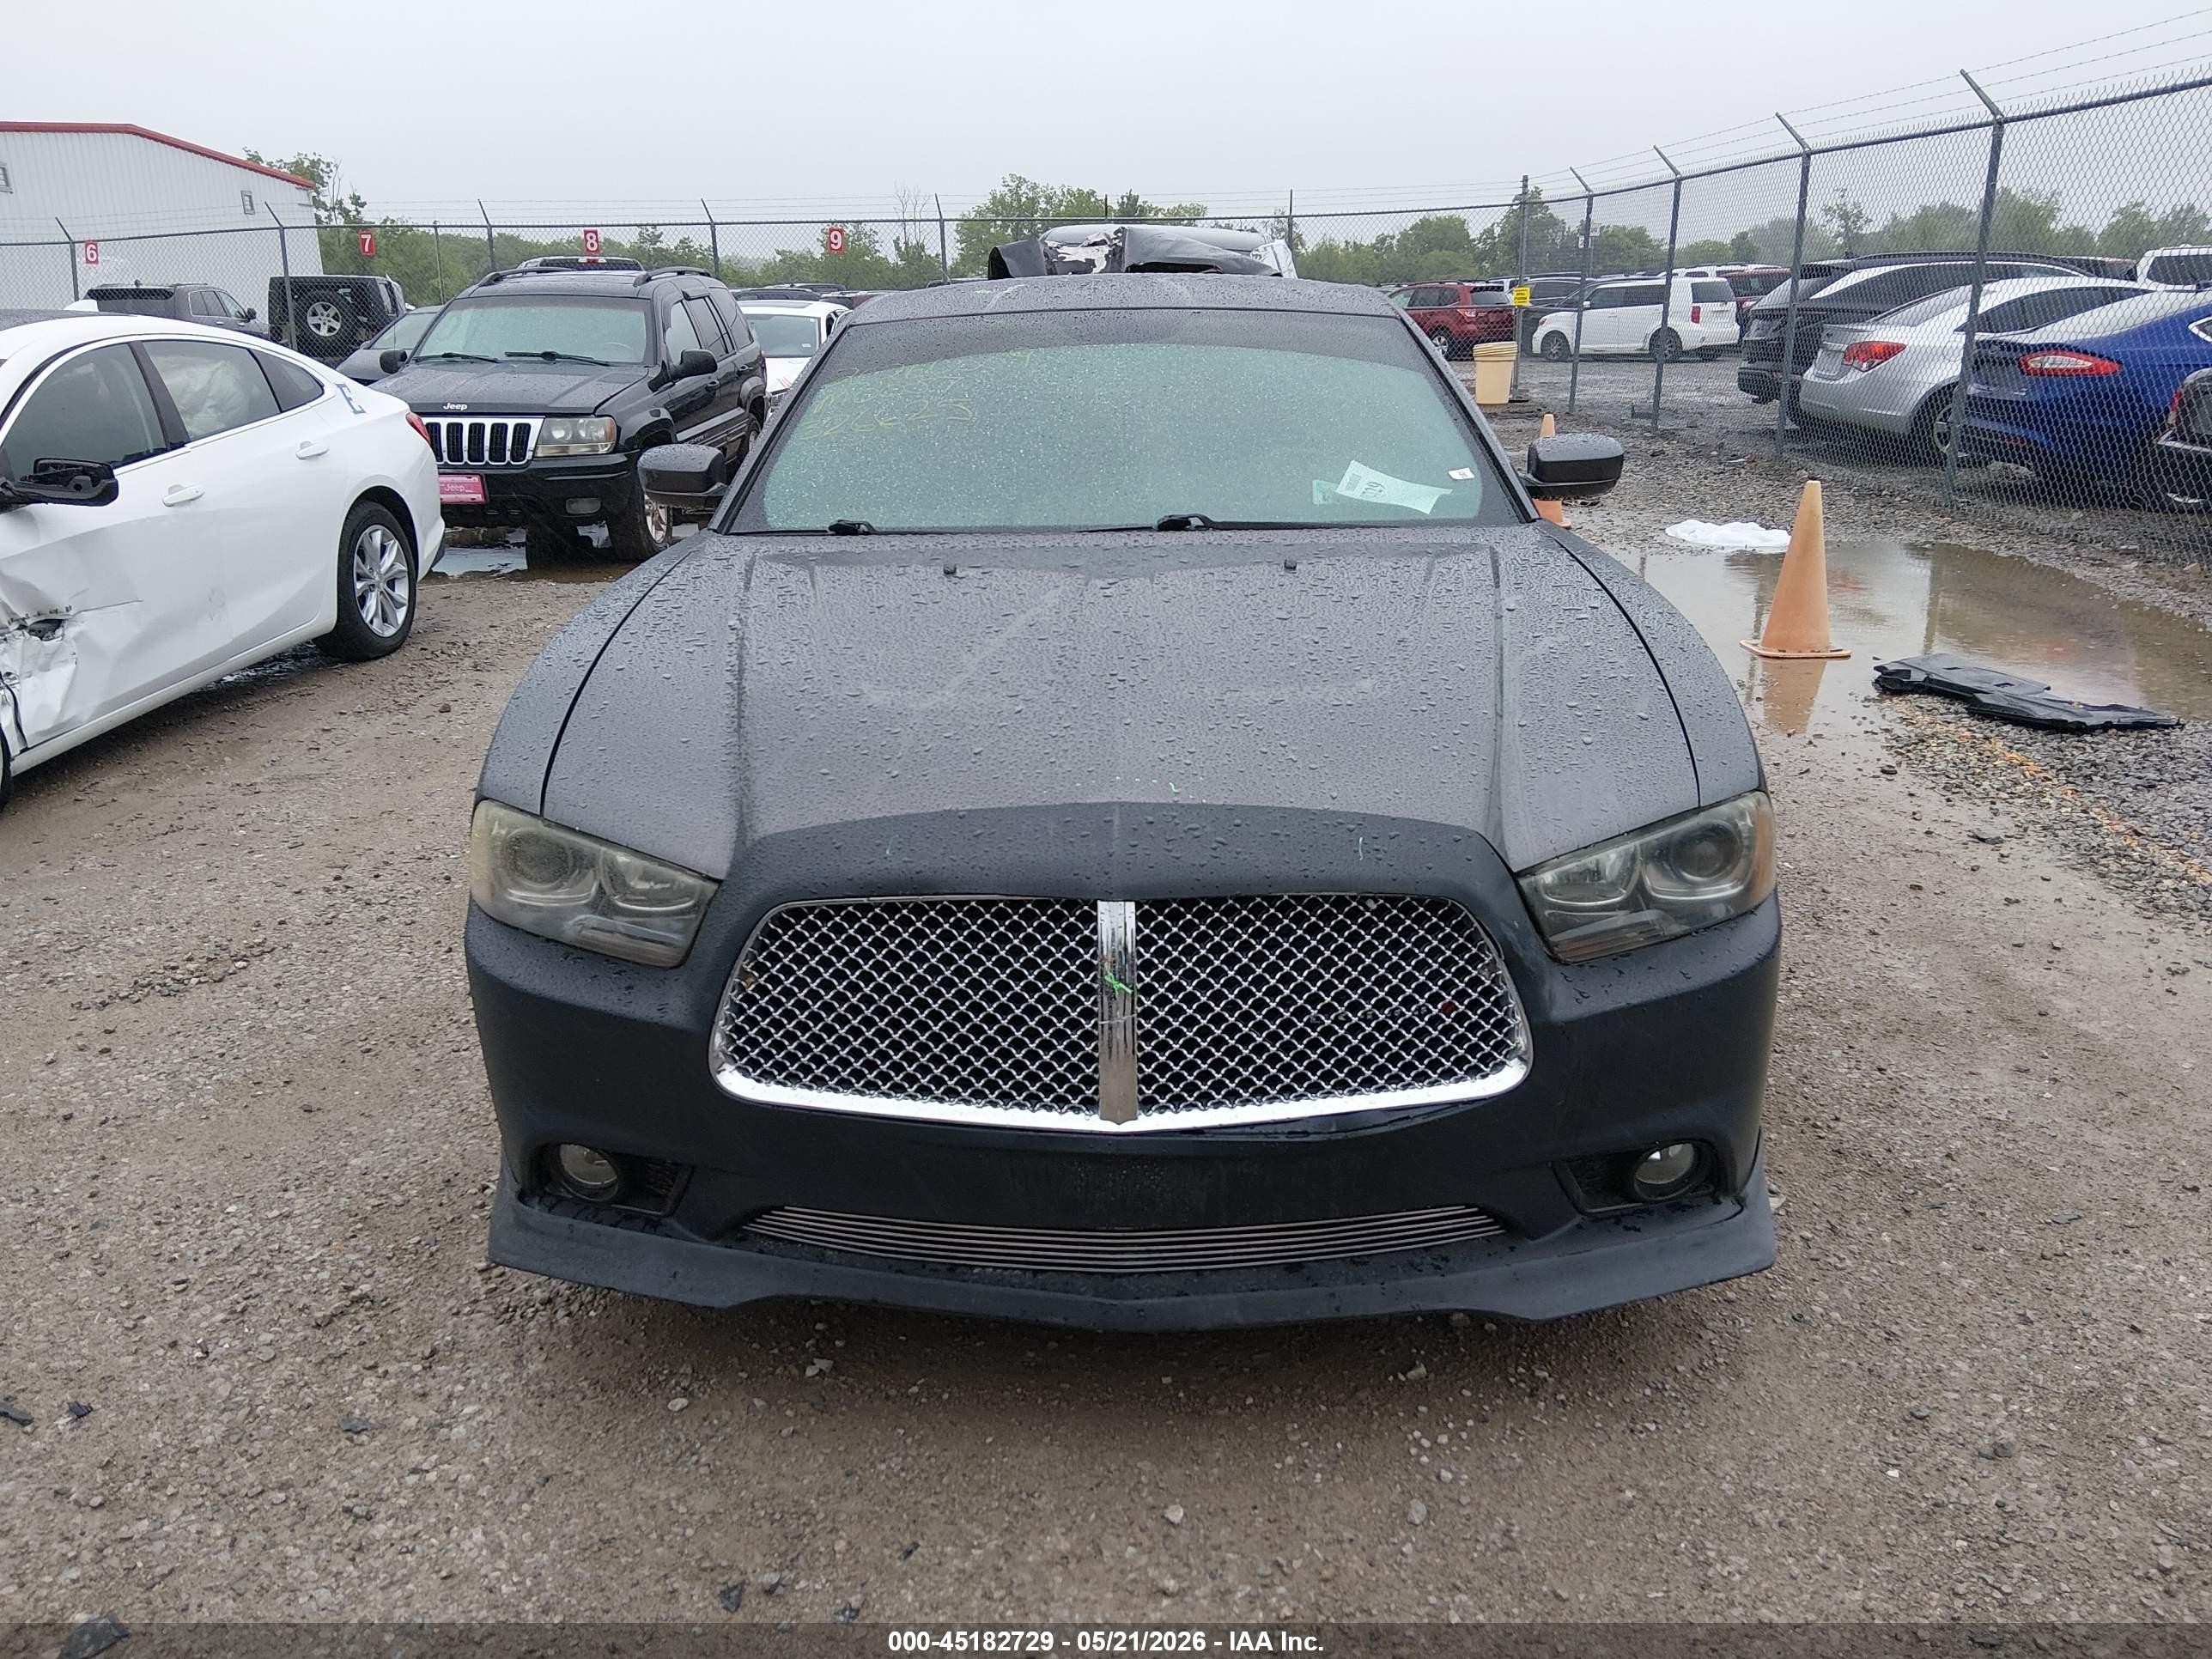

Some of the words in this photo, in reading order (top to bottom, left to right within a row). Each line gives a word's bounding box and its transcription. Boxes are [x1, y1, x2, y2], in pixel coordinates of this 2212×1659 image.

[361, 234, 373, 252] 7
[586, 232, 599, 251] 8
[830, 230, 843, 250] 9
[86, 243, 98, 262] 6
[445, 483, 465, 492] Jeep
